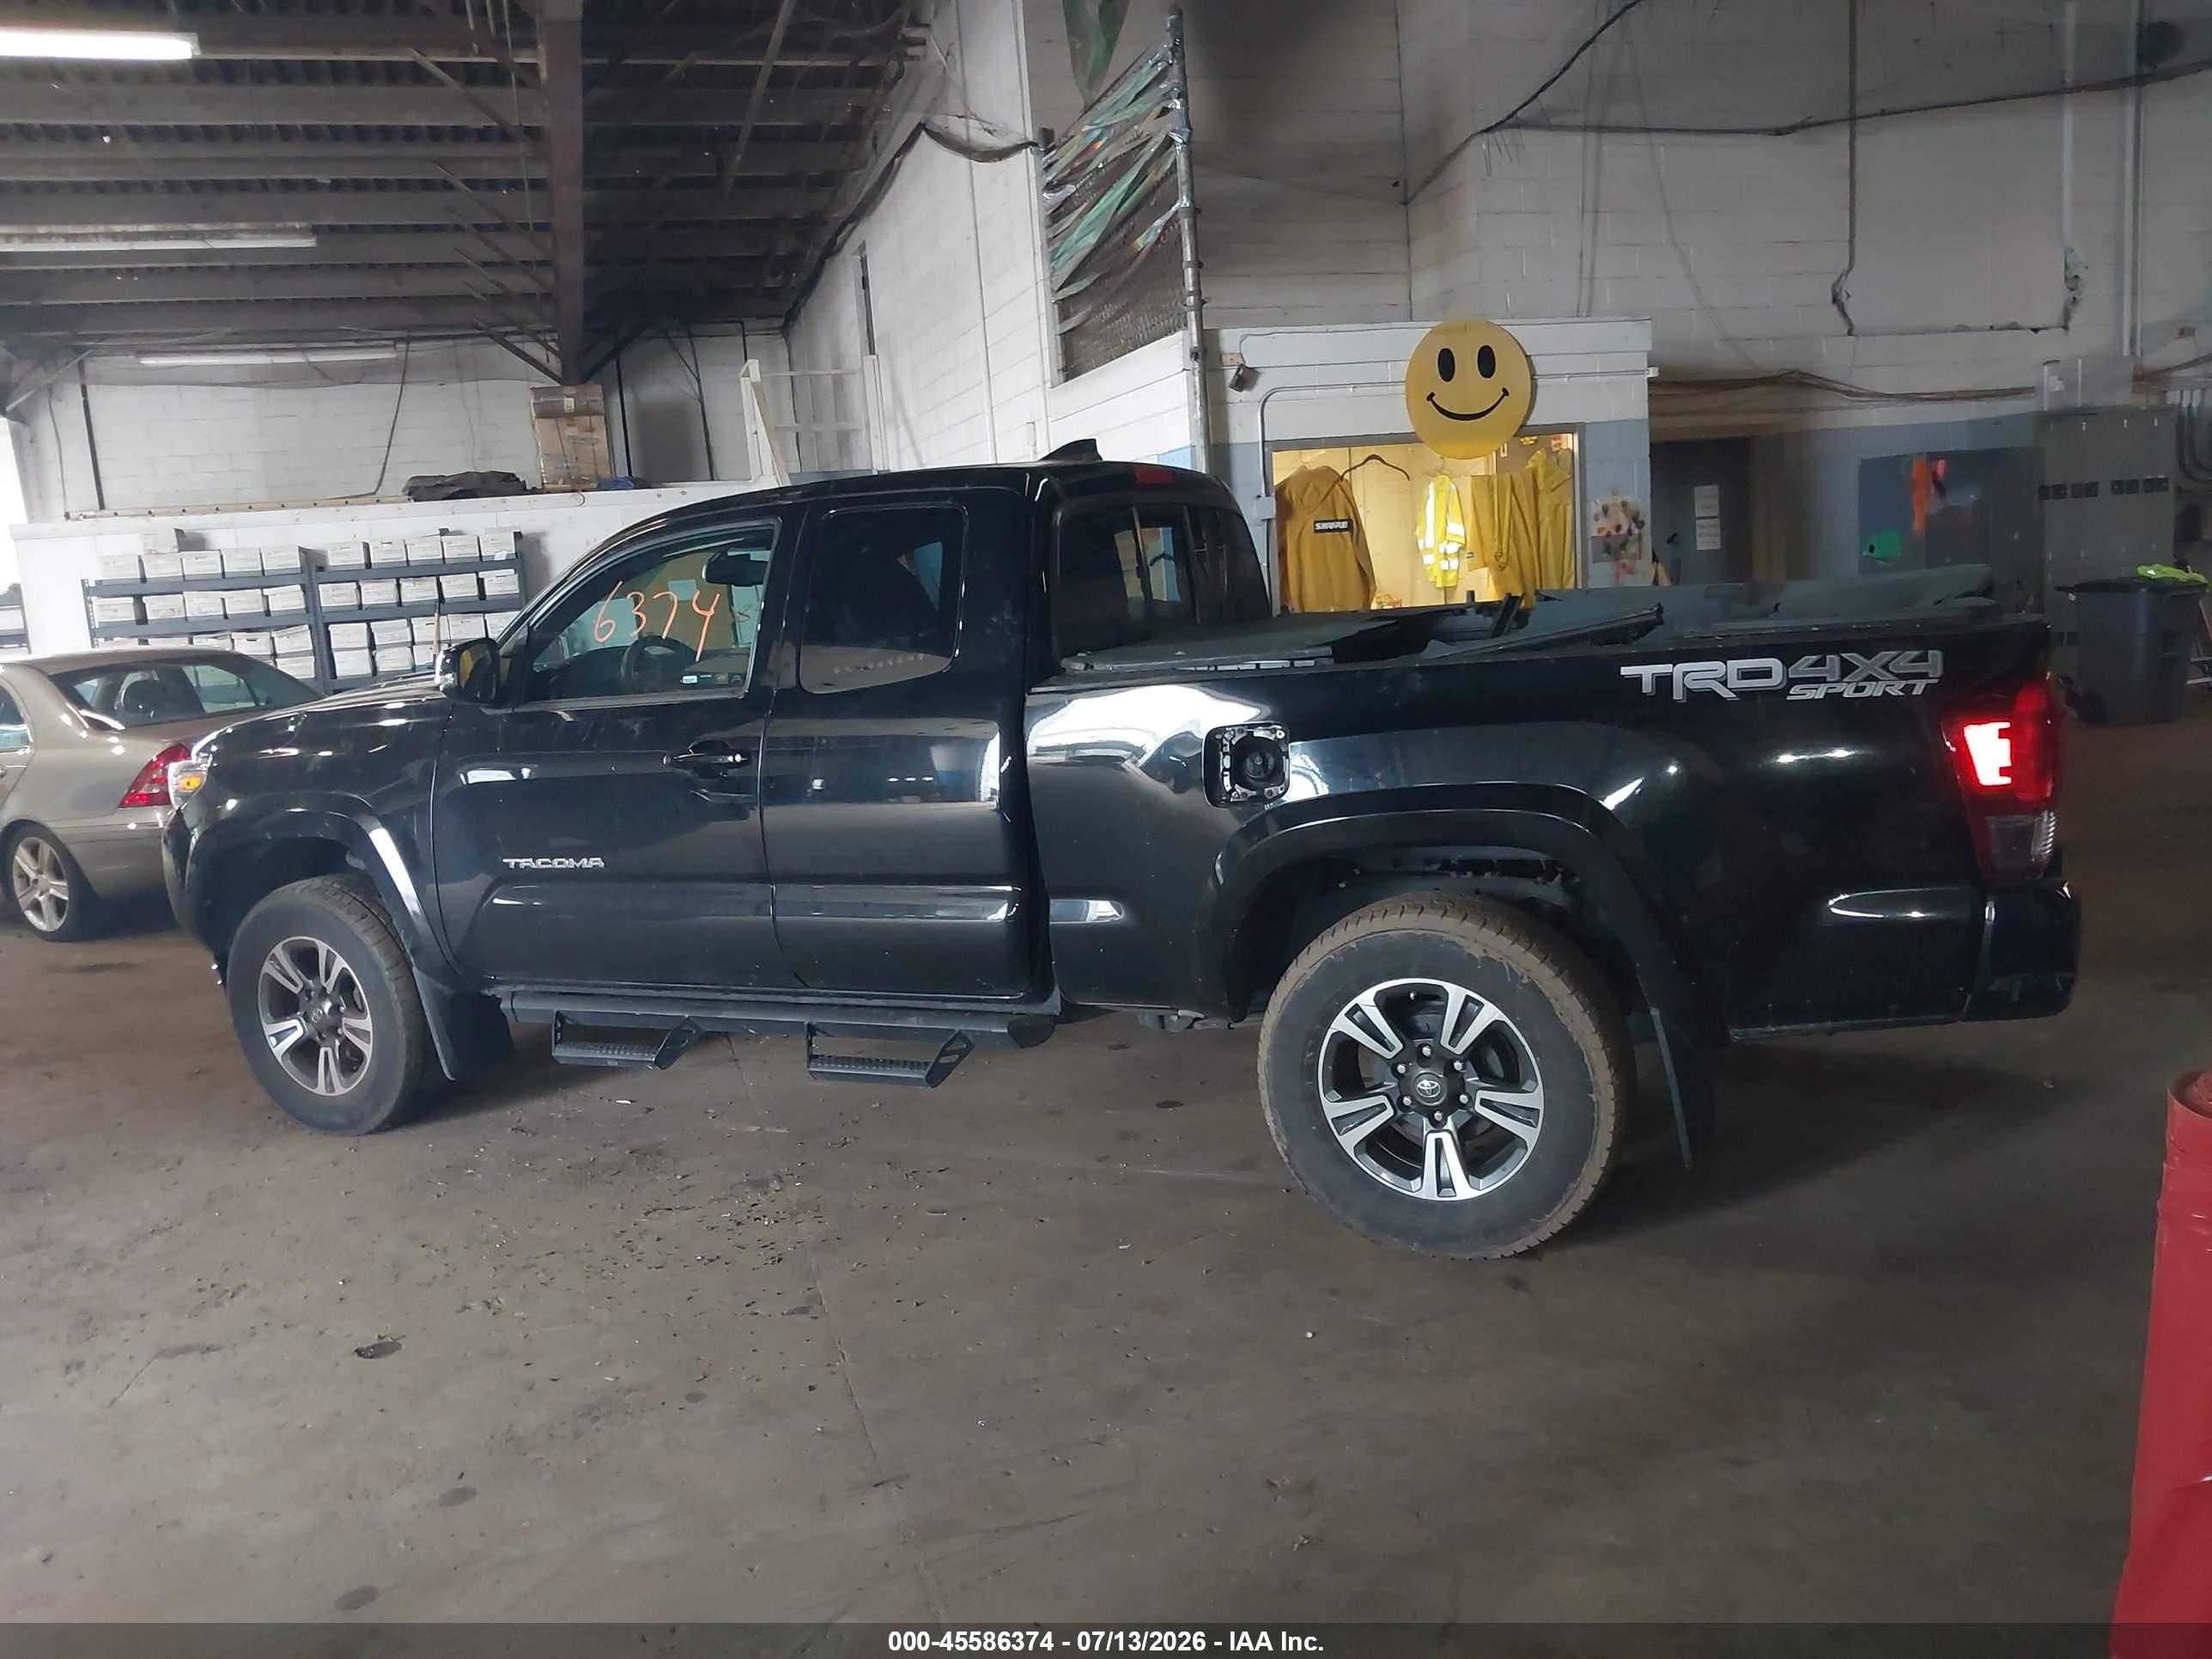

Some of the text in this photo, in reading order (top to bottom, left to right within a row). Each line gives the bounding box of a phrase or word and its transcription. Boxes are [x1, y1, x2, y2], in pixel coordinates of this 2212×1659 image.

[593, 580, 721, 663] 6374
[1620, 649, 1944, 702] TRD 4X4
[1785, 678, 1940, 701] SPORT
[501, 857, 605, 869] TACOMA
